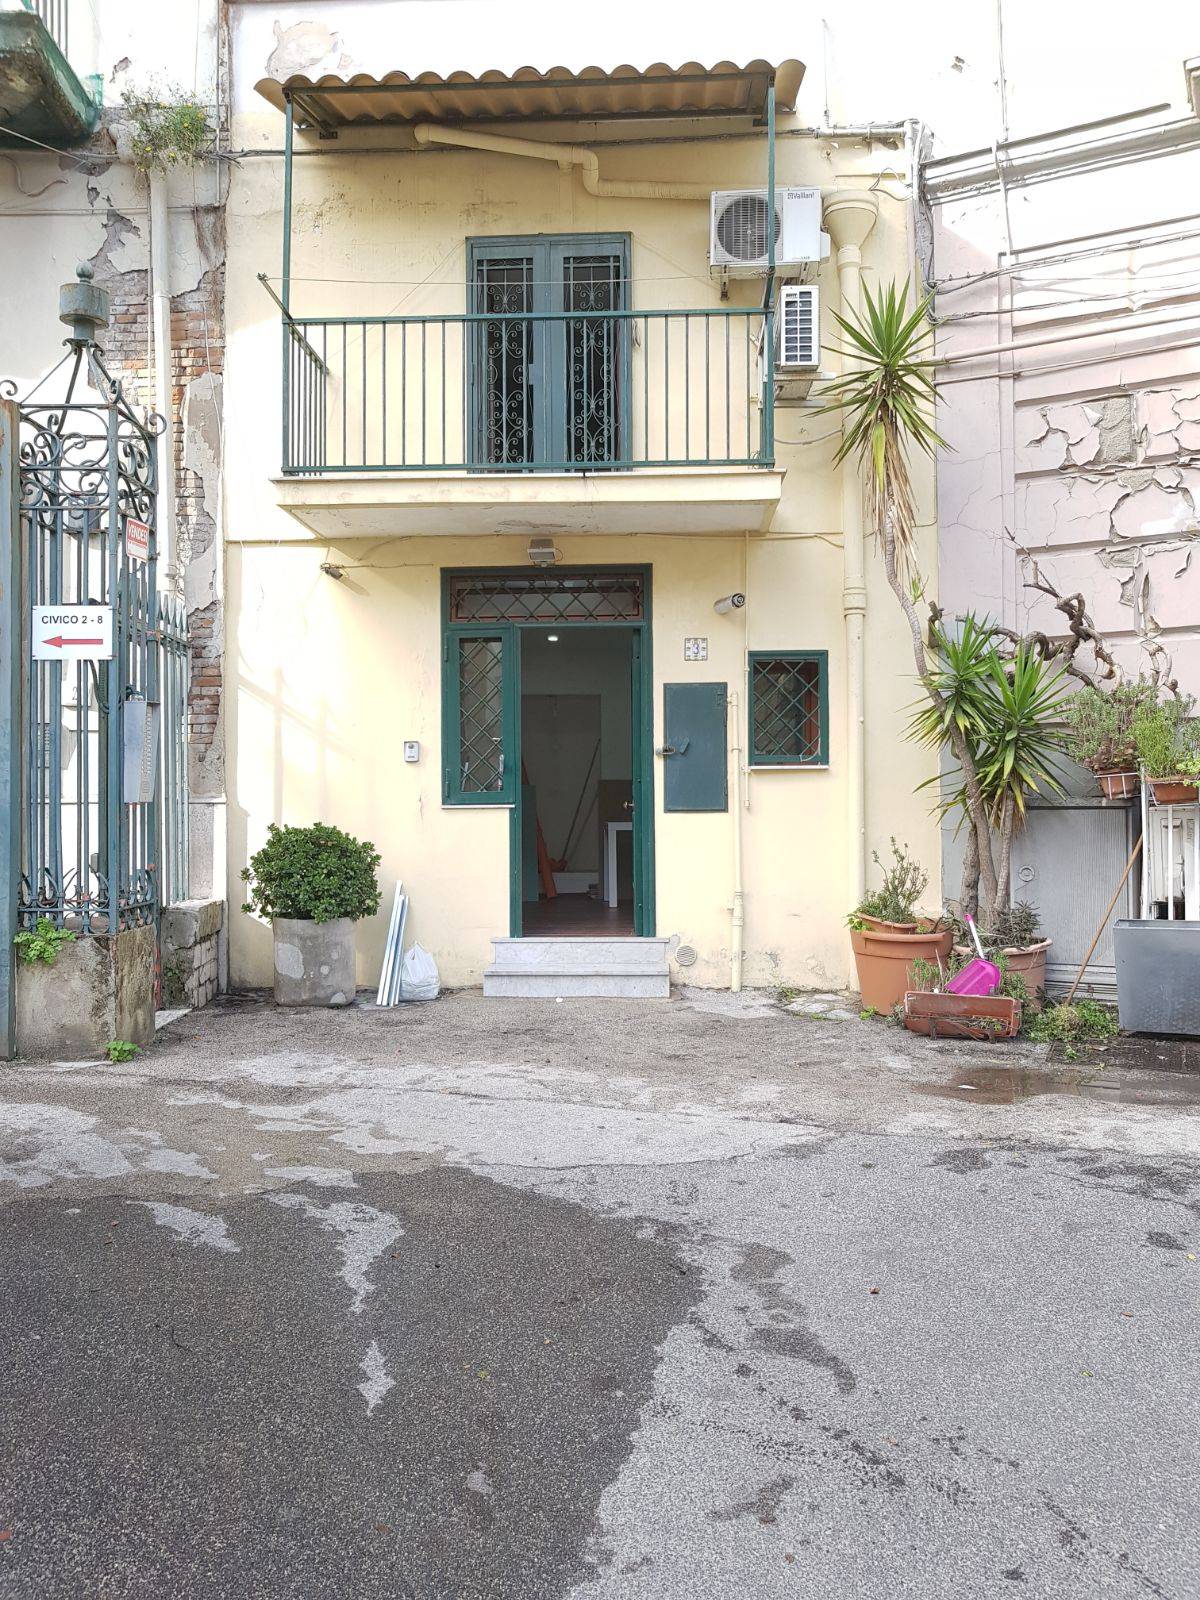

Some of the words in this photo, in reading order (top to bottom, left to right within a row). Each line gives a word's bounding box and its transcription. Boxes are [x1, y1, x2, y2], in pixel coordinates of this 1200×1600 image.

[41, 615, 78, 624] CIVICO
[81, 615, 87, 624] 2
[97, 615, 103, 624] 8
[692, 643, 699, 654] 3
